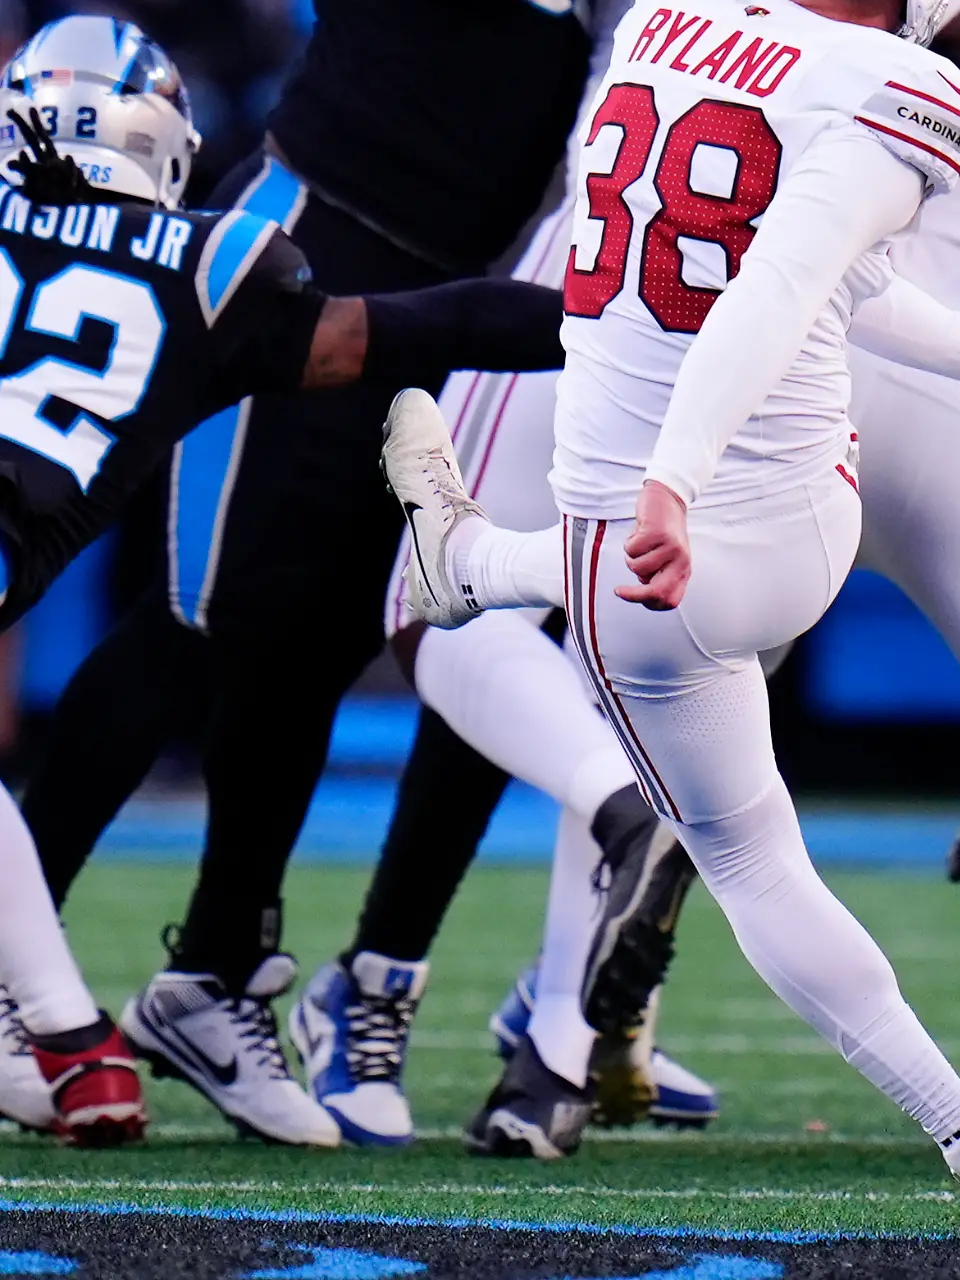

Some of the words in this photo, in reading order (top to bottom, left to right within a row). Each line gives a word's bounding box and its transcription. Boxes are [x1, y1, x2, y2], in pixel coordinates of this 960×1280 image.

[628, 7, 801, 98] RYLAND
[40, 105, 98, 139] 32
[130, 211, 194, 271] JR
[562, 81, 783, 335] 38
[0, 245, 167, 496] 2
